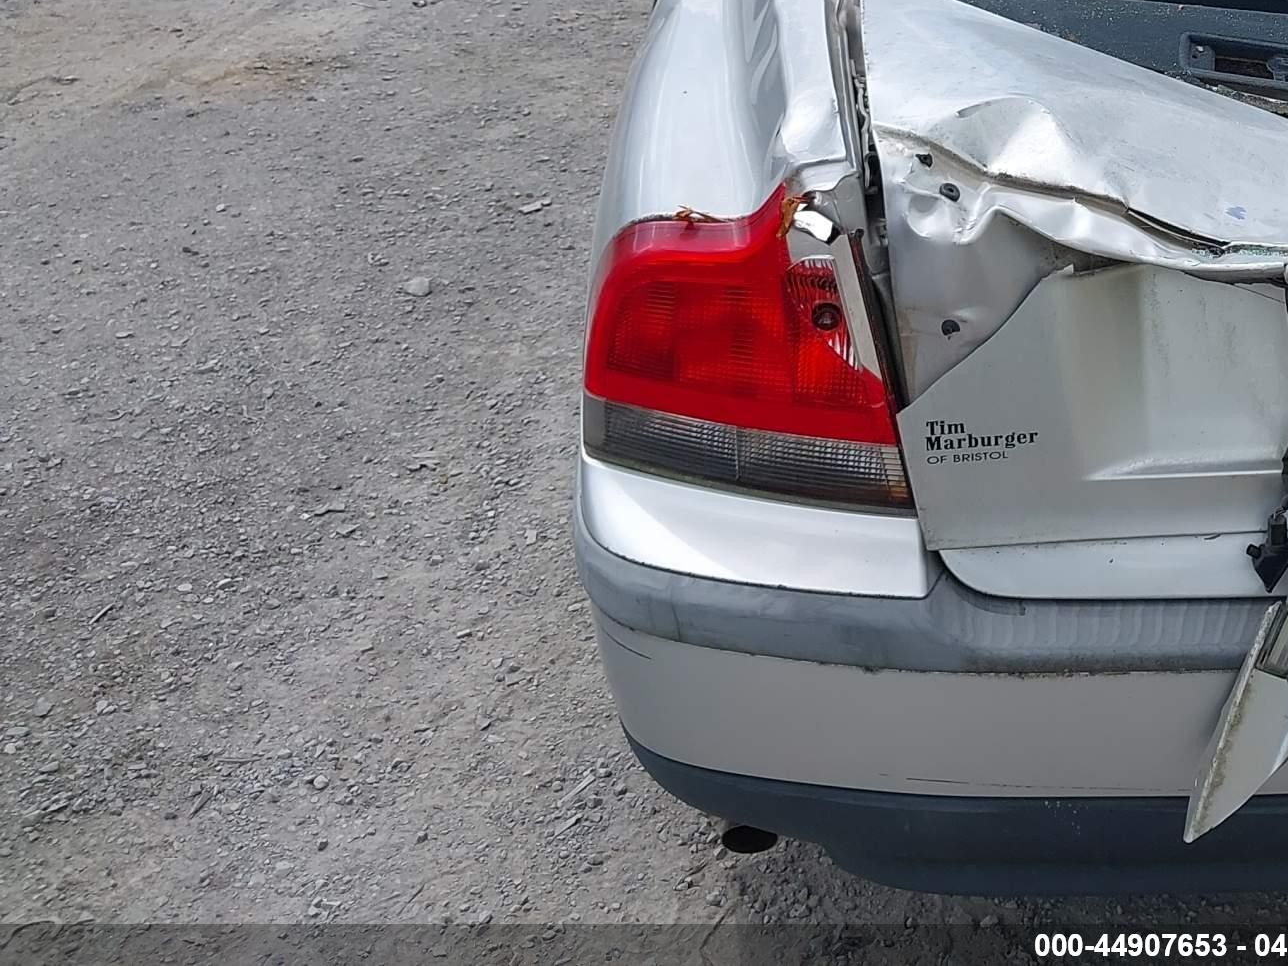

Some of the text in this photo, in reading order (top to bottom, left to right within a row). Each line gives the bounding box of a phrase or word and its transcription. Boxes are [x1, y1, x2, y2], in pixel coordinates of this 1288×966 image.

[926, 420, 966, 436] Tim
[926, 432, 1038, 451] Marburger
[927, 451, 1008, 464] OF BRISTOL
